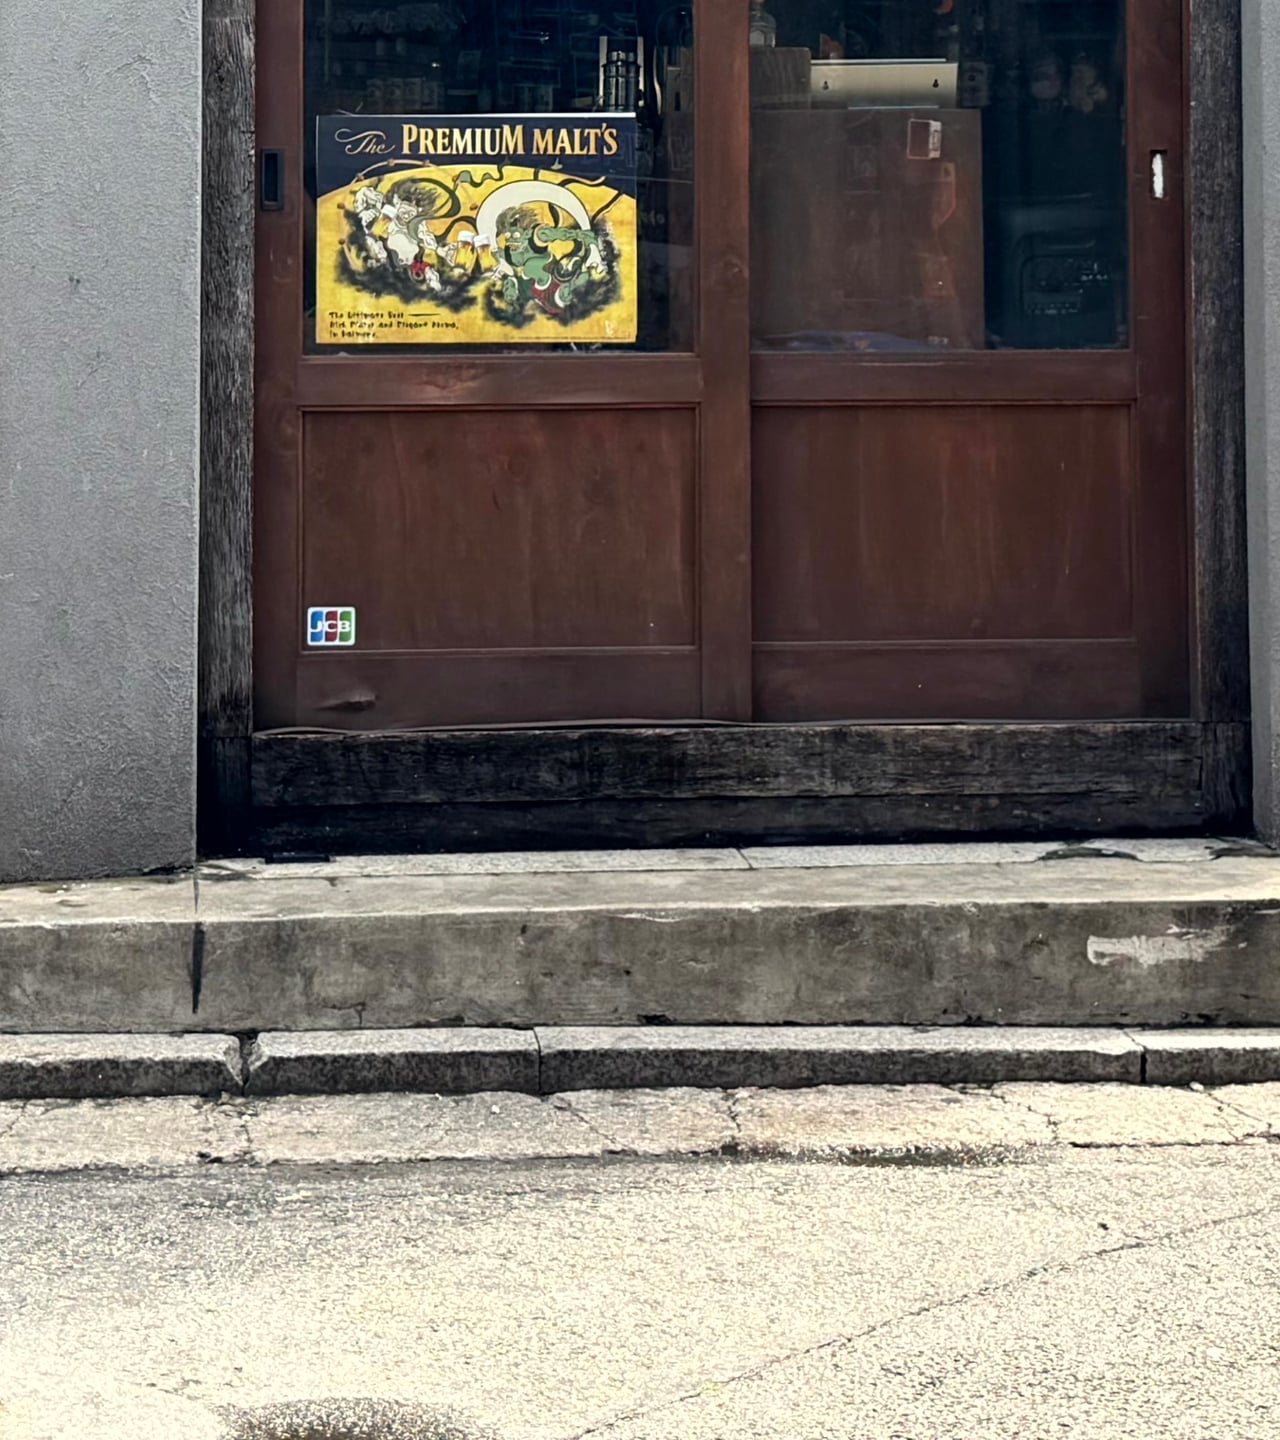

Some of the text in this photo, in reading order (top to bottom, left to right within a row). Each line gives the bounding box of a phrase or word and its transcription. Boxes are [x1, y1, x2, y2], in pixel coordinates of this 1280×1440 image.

[334, 122, 619, 157] The PREMIUM MALT'S
[309, 620, 353, 633] JCB
